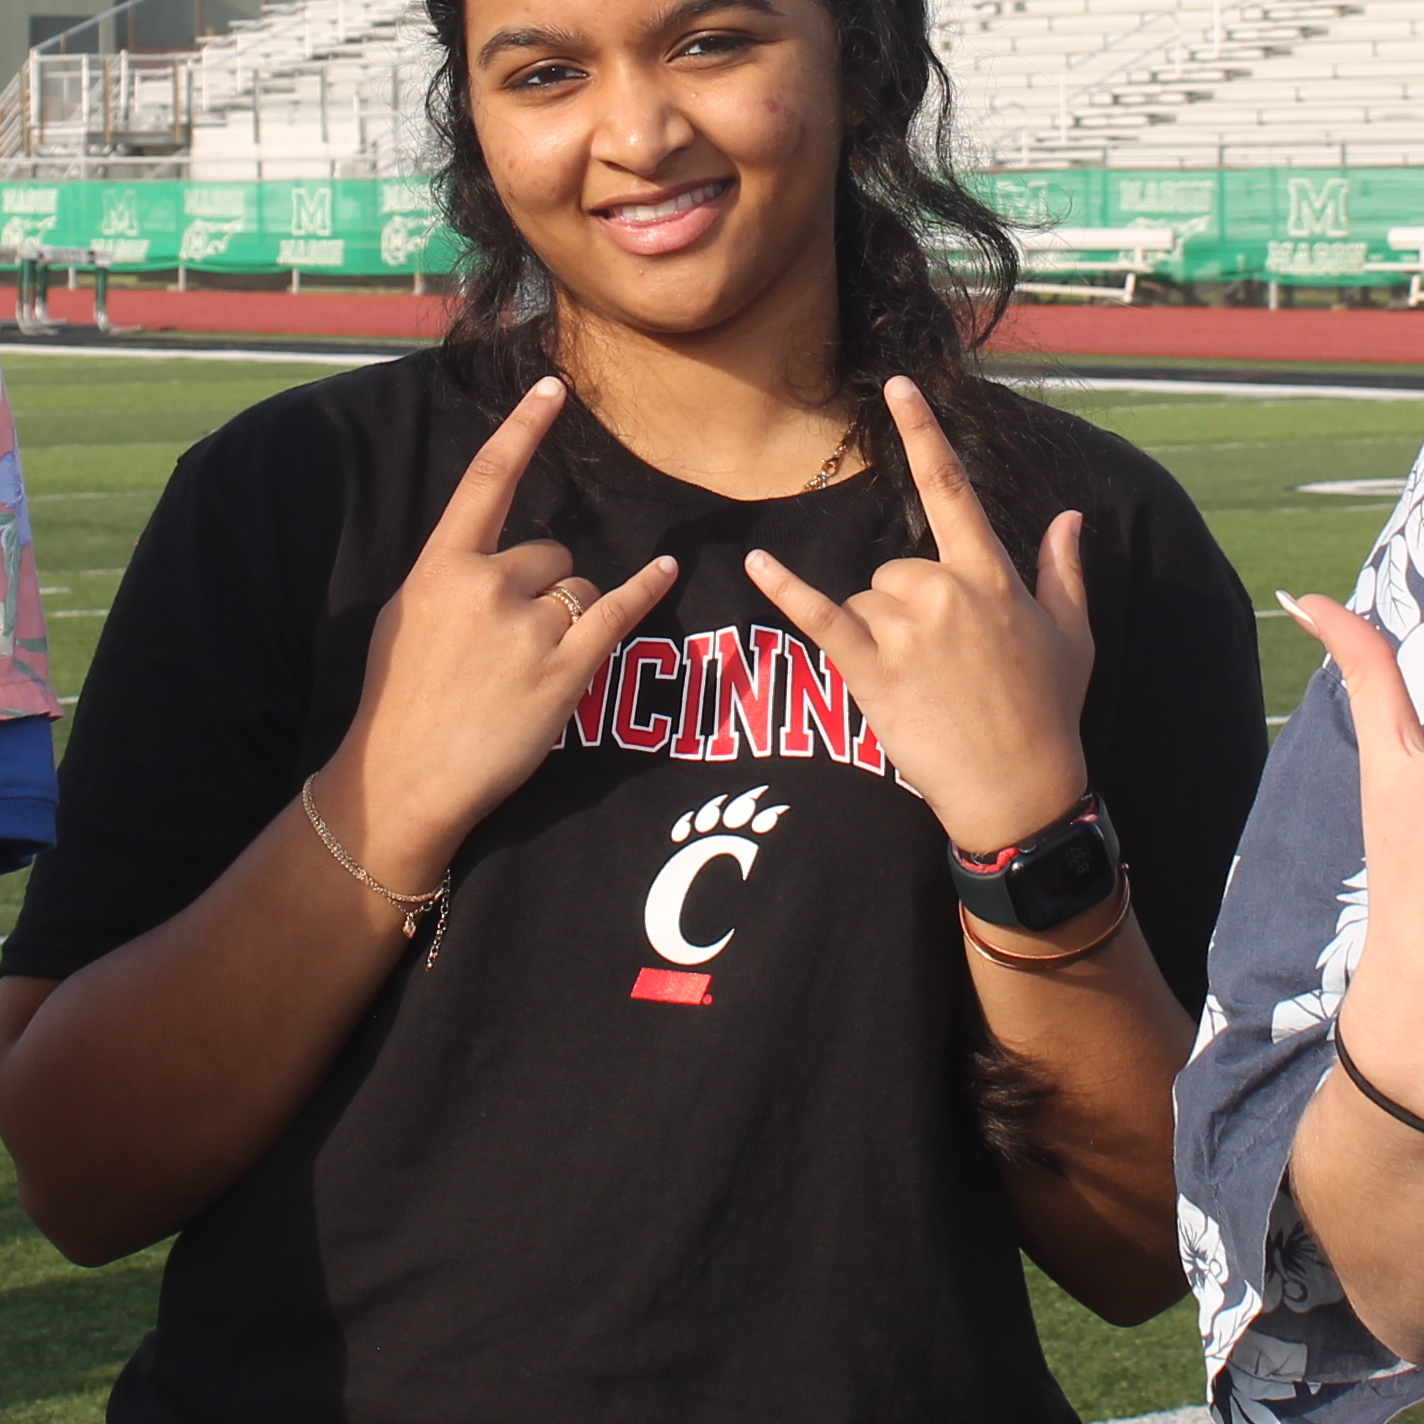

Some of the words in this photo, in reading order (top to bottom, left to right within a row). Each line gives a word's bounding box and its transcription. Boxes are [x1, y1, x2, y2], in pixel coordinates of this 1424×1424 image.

[291, 187, 332, 236] M
[1287, 176, 1350, 237] M
[1265, 240, 1370, 276] MASON
[643, 833, 760, 966] C
